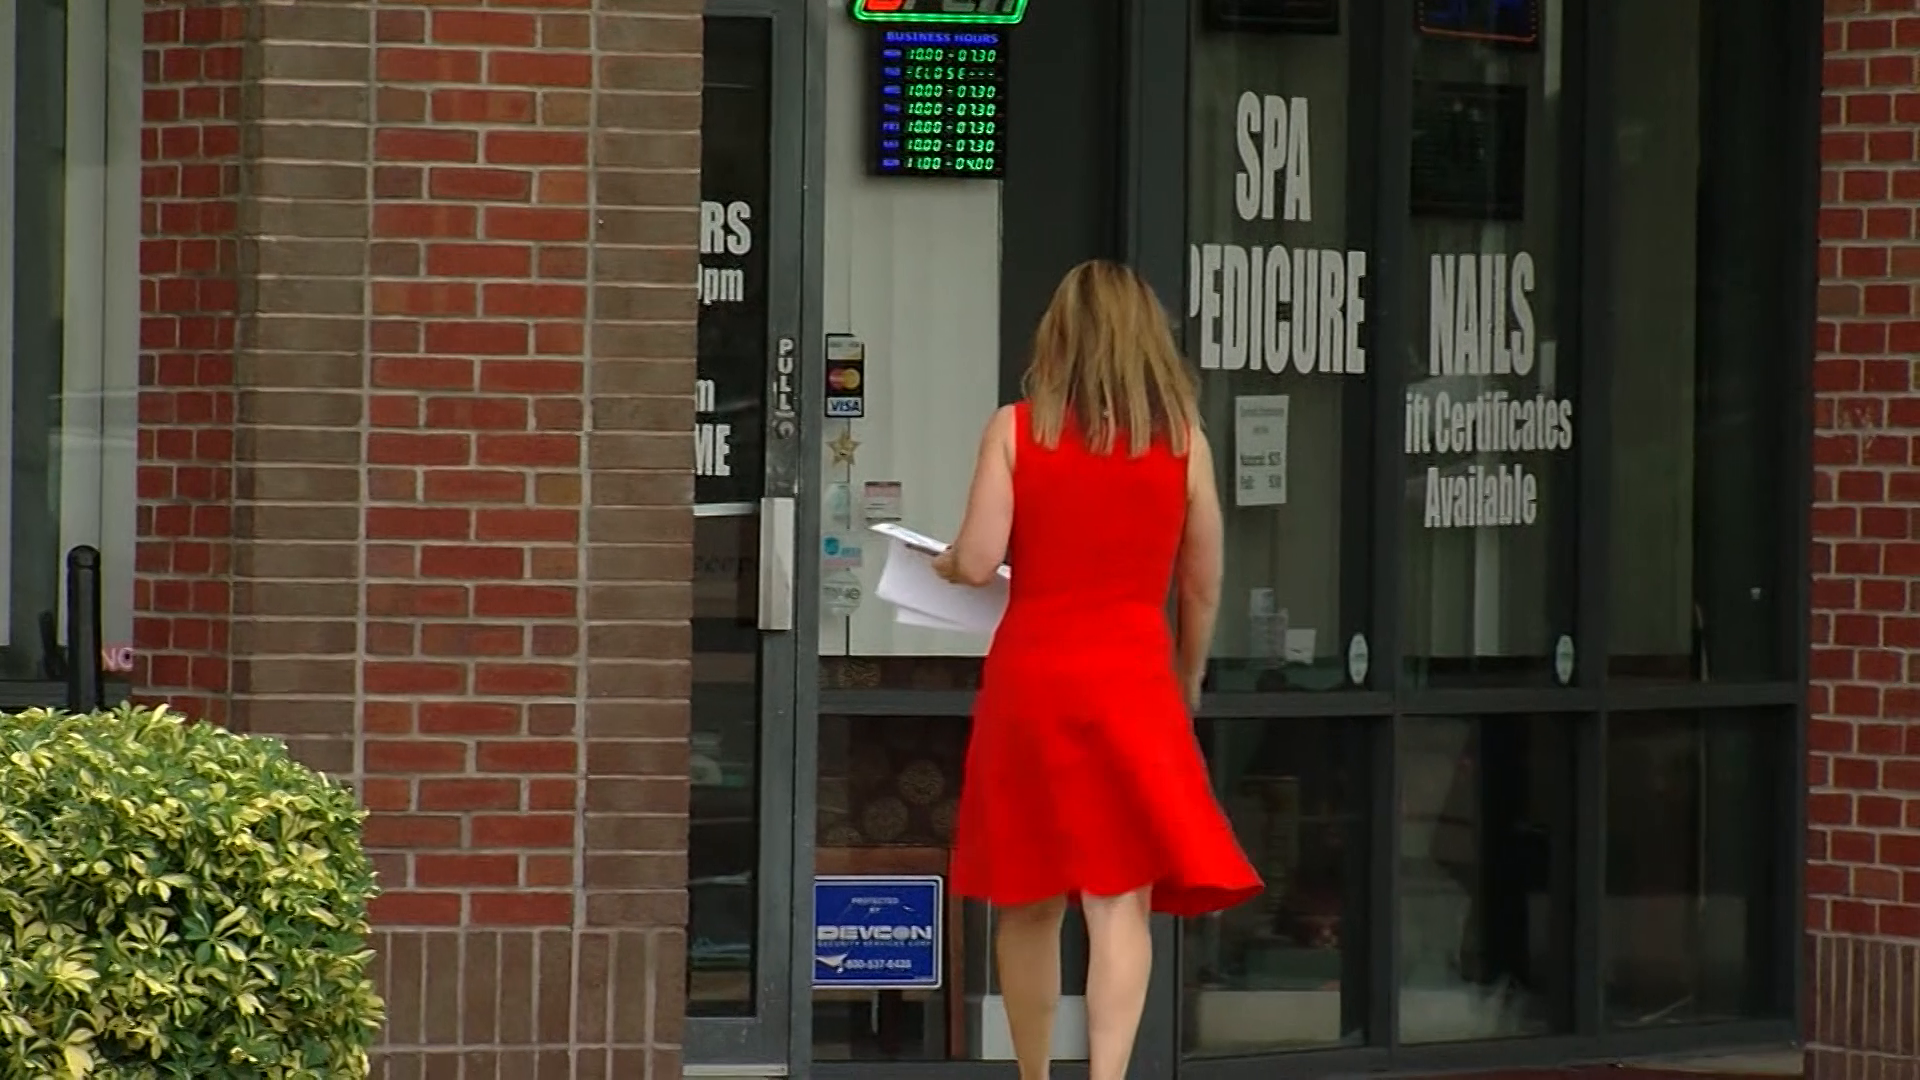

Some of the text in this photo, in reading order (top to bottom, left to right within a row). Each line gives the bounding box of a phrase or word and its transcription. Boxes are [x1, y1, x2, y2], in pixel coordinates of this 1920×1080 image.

[885, 32, 999, 44] BUSINESS HOURS
[1235, 91, 1312, 222] SPA
[700, 201, 752, 255] RS
[698, 263, 745, 305] pm
[1429, 251, 1535, 376] NAILS
[777, 338, 794, 410] PULL
[830, 399, 861, 412] VISA
[1435, 391, 1573, 454] Certificates
[1424, 464, 1538, 529] Available
[851, 896, 900, 906] PROTECTED
[816, 924, 932, 941] DEVCON
